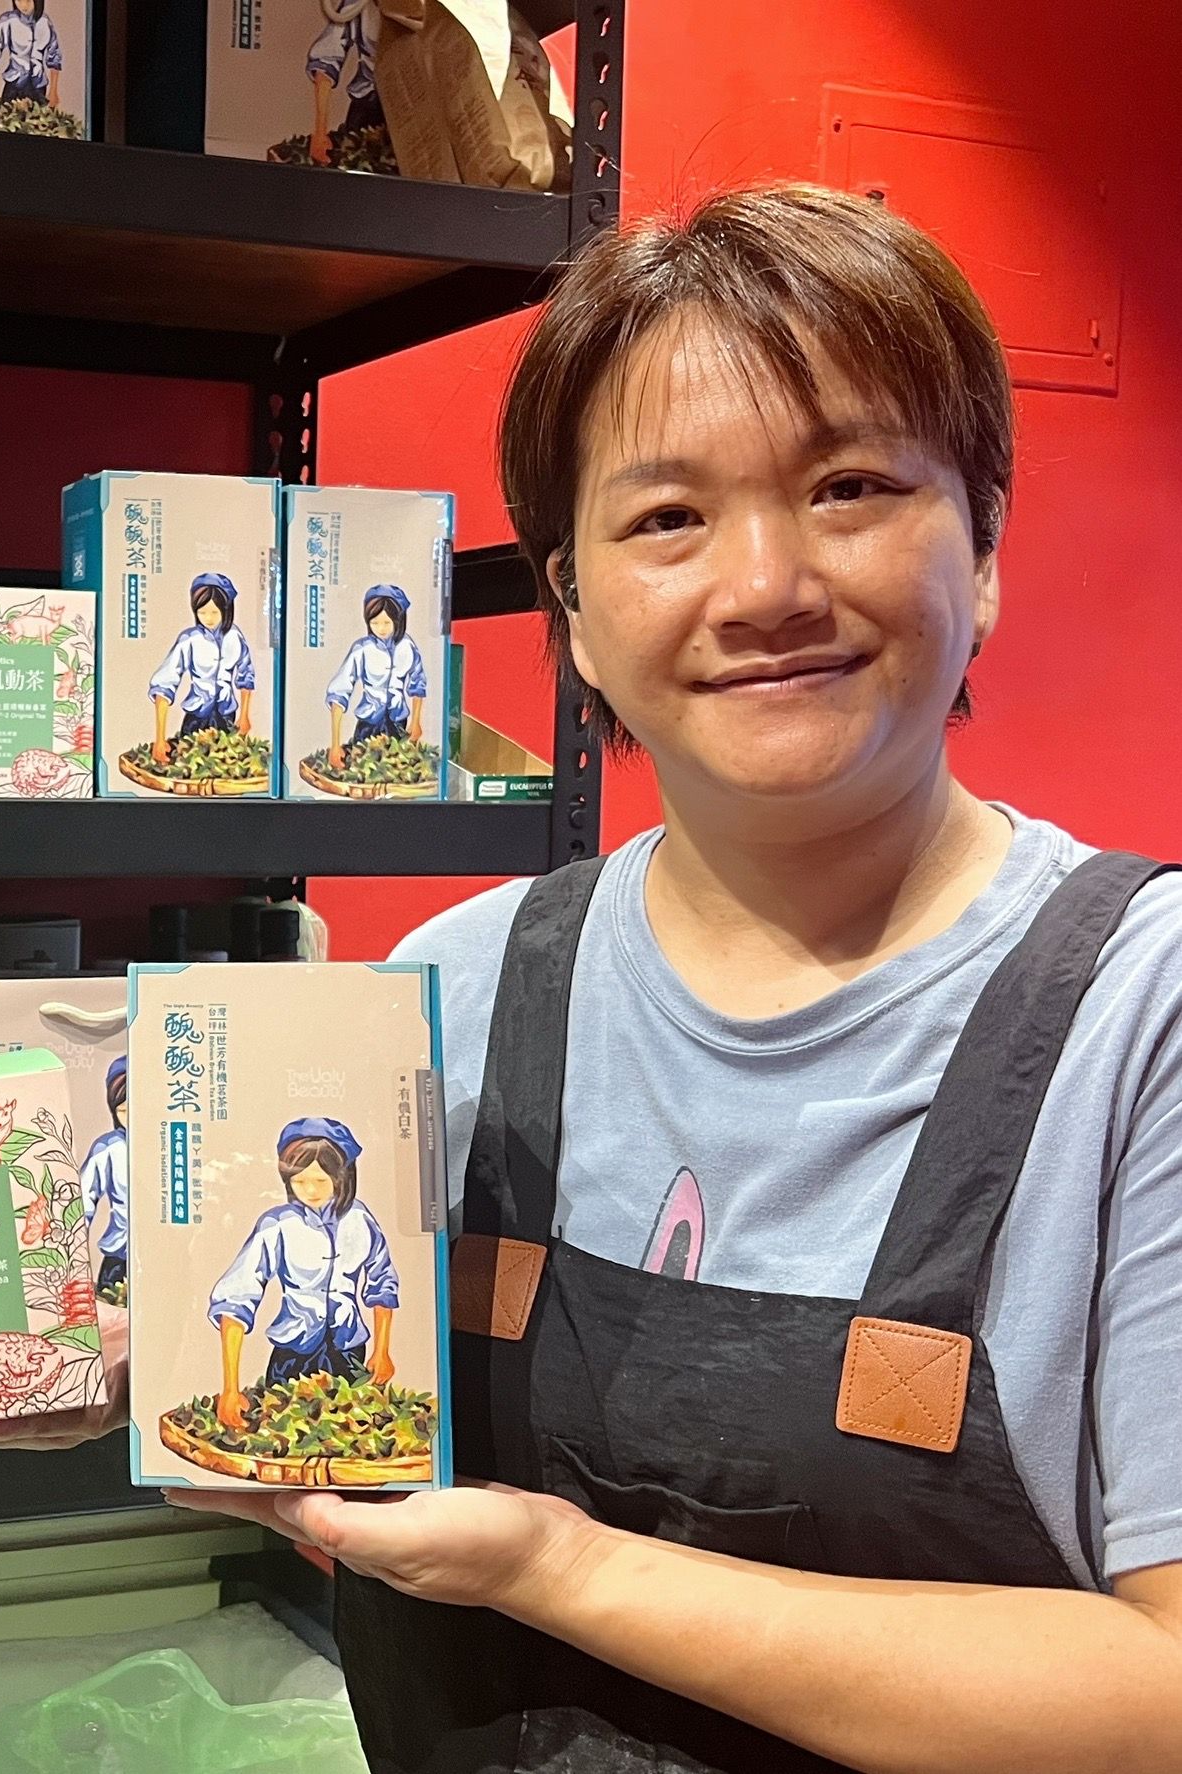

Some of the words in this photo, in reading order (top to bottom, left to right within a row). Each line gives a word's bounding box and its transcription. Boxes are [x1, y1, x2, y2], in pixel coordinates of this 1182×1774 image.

[509, 782, 547, 791] EUCALYPTUS
[398, 1088, 413, 1140] 有機白茶
[160, 1191, 168, 1224] Farming
